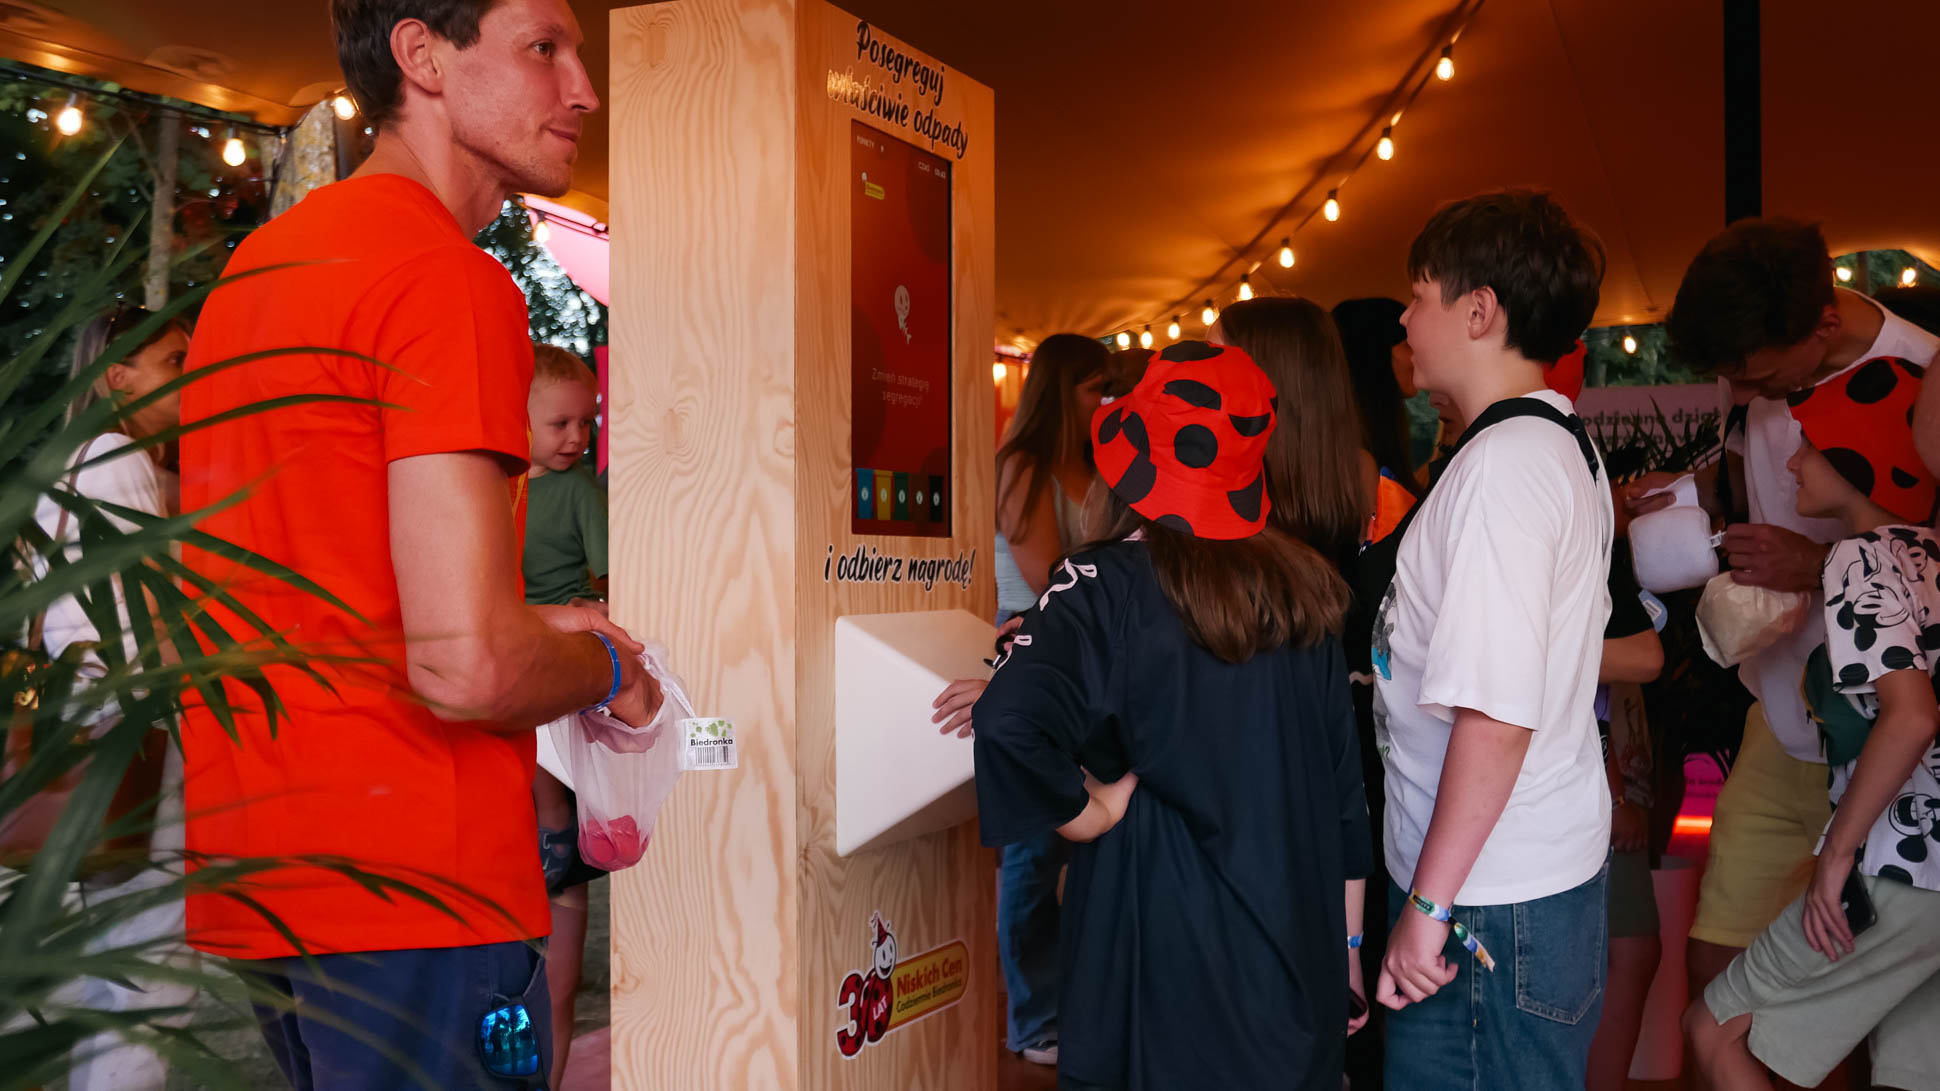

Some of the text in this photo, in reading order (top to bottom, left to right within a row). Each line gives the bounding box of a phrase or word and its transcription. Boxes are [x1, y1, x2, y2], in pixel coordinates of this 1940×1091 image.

[856, 20, 945, 106] Posegreguj
[827, 66, 968, 159] właściwie odpady
[825, 544, 976, 592] i odbierz nagrodę!
[690, 738, 733, 747] Biedronka
[897, 958, 962, 998] Niskich Cen
[837, 968, 894, 1057] 30
[872, 996, 888, 1020] LAT
